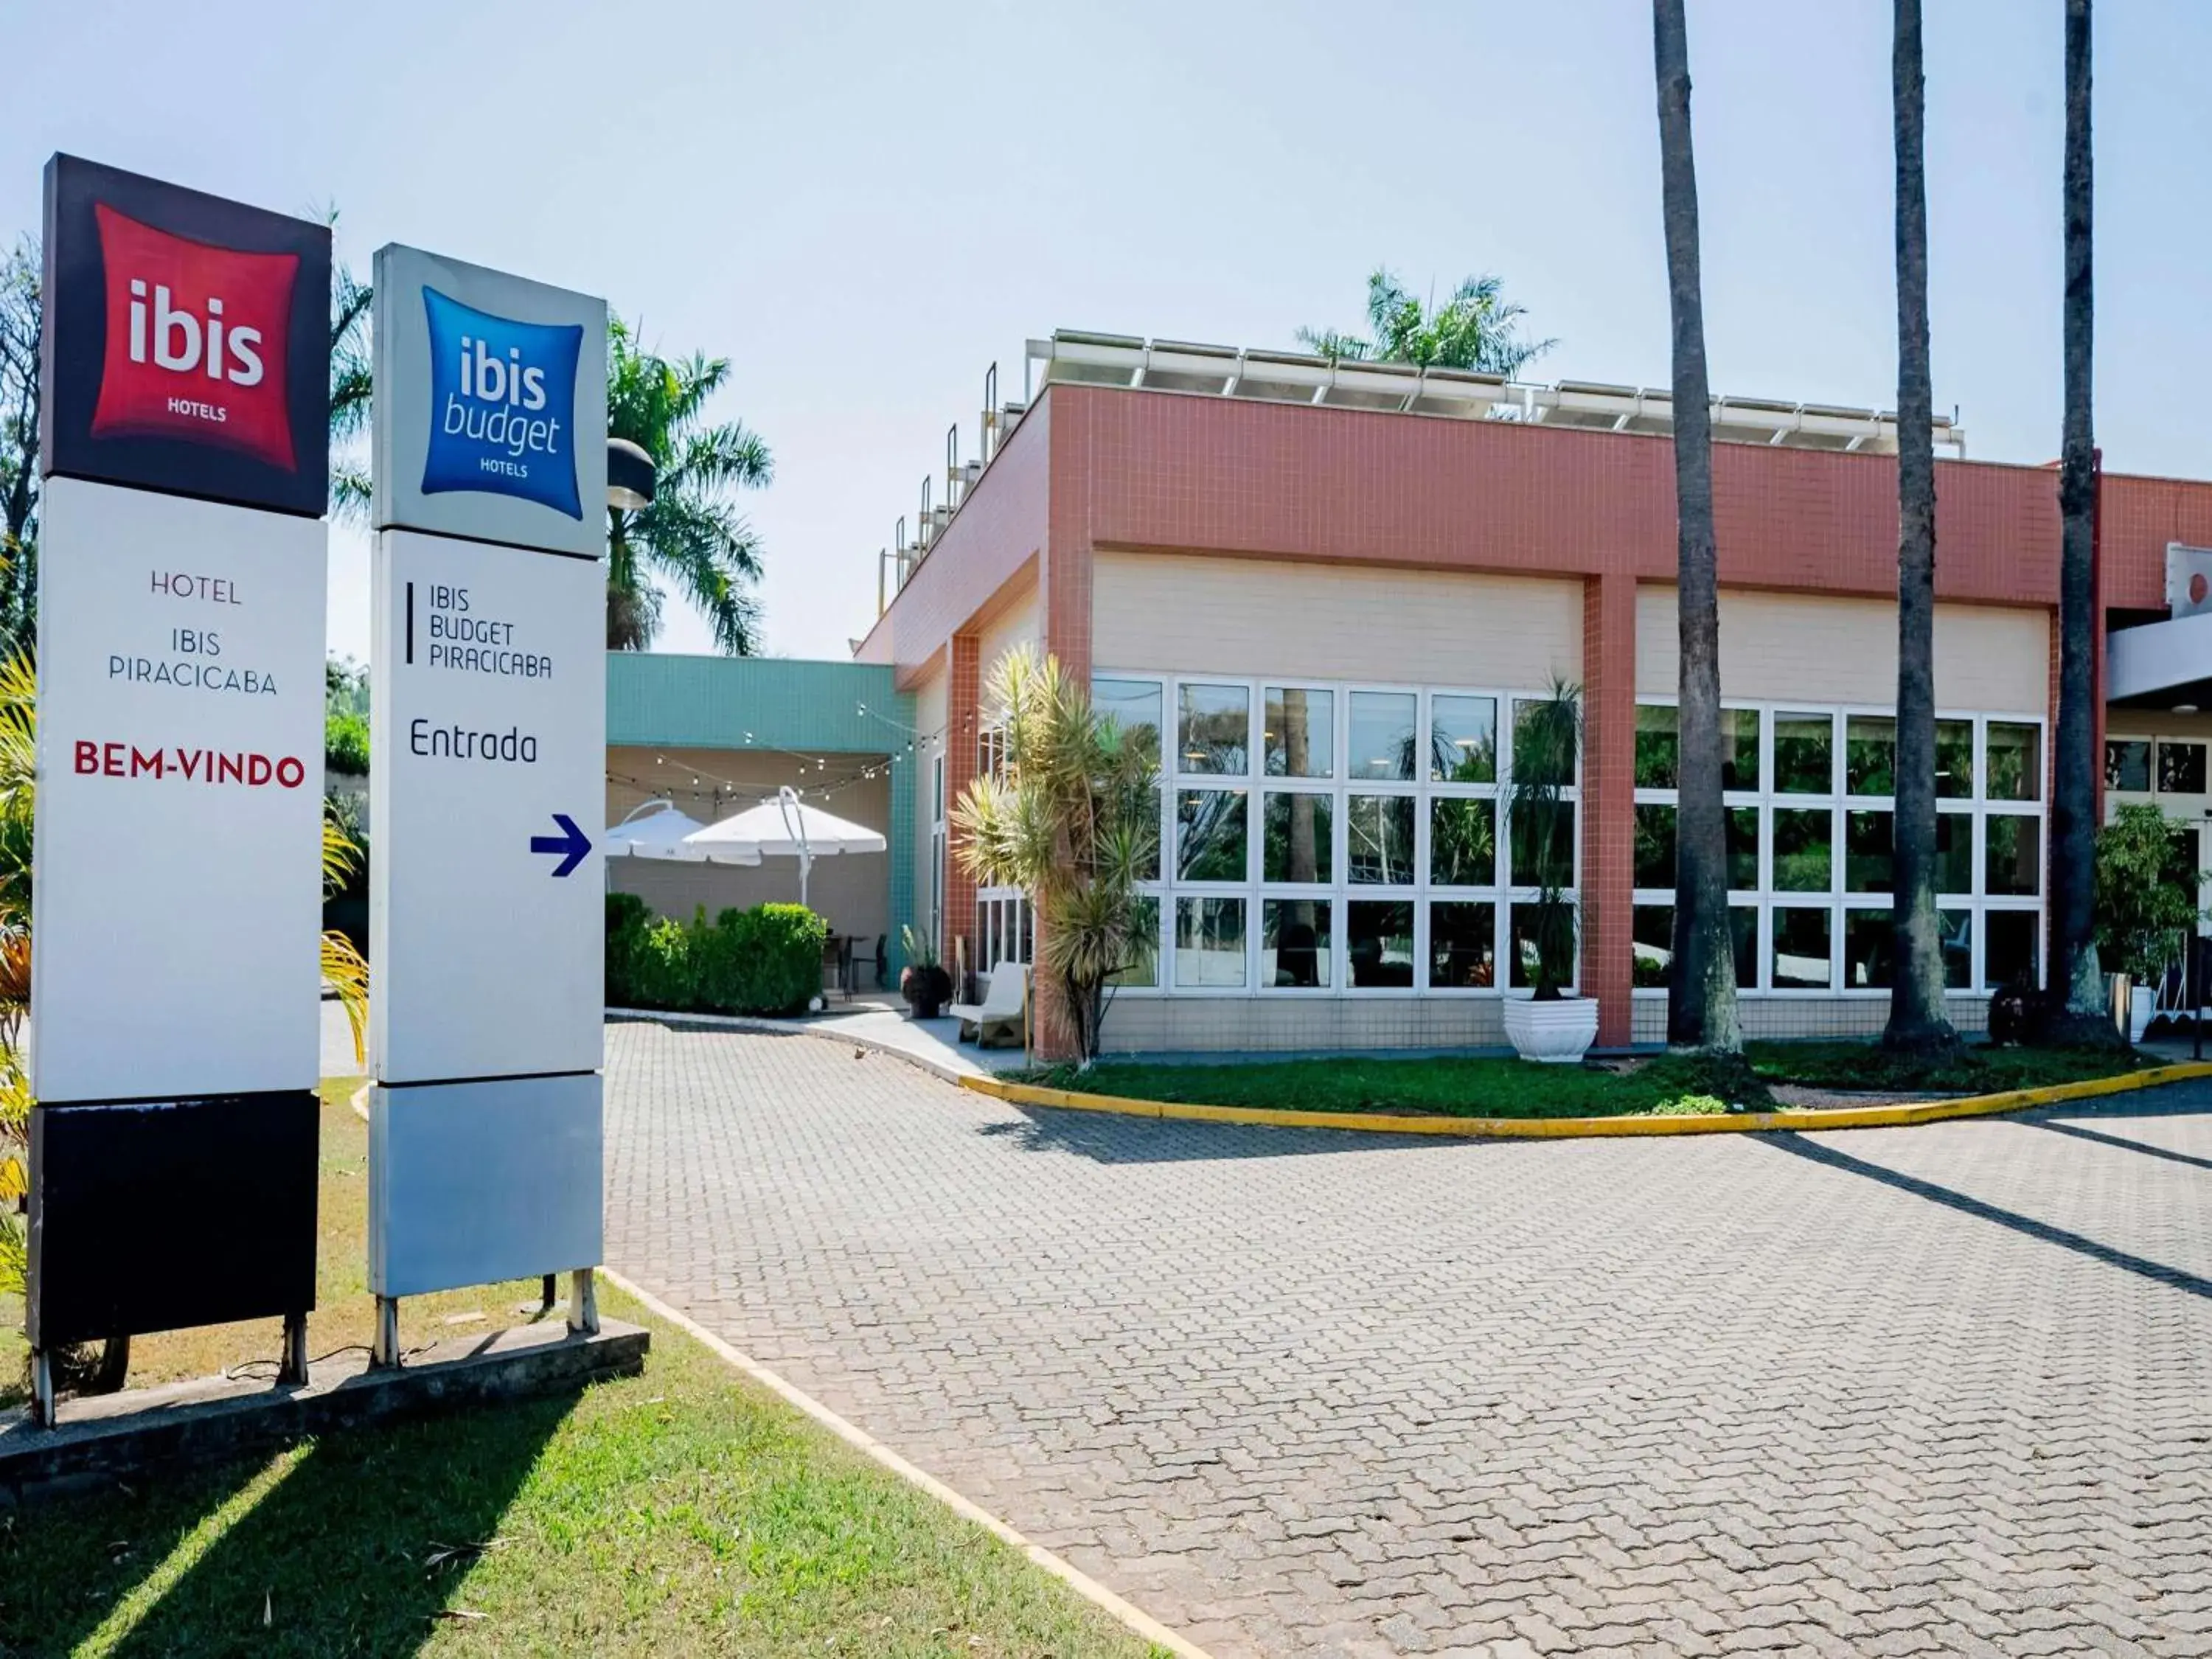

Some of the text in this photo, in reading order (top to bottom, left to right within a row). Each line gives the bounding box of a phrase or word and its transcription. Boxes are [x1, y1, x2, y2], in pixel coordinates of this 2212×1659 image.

[131, 279, 264, 386] ibis
[462, 336, 546, 411] ibis
[168, 397, 226, 422] HOTELS
[445, 392, 560, 456] budget
[481, 457, 528, 478] HOTELS
[151, 570, 242, 605] HOTEL
[431, 585, 469, 611] IBIS
[172, 628, 221, 656] IBIS
[431, 615, 514, 646] BUDGET
[109, 655, 276, 695] PIRACICABA
[430, 644, 552, 678] PIRACICABA
[411, 718, 538, 763] Entrada
[74, 740, 305, 789] BEM-VINDO
